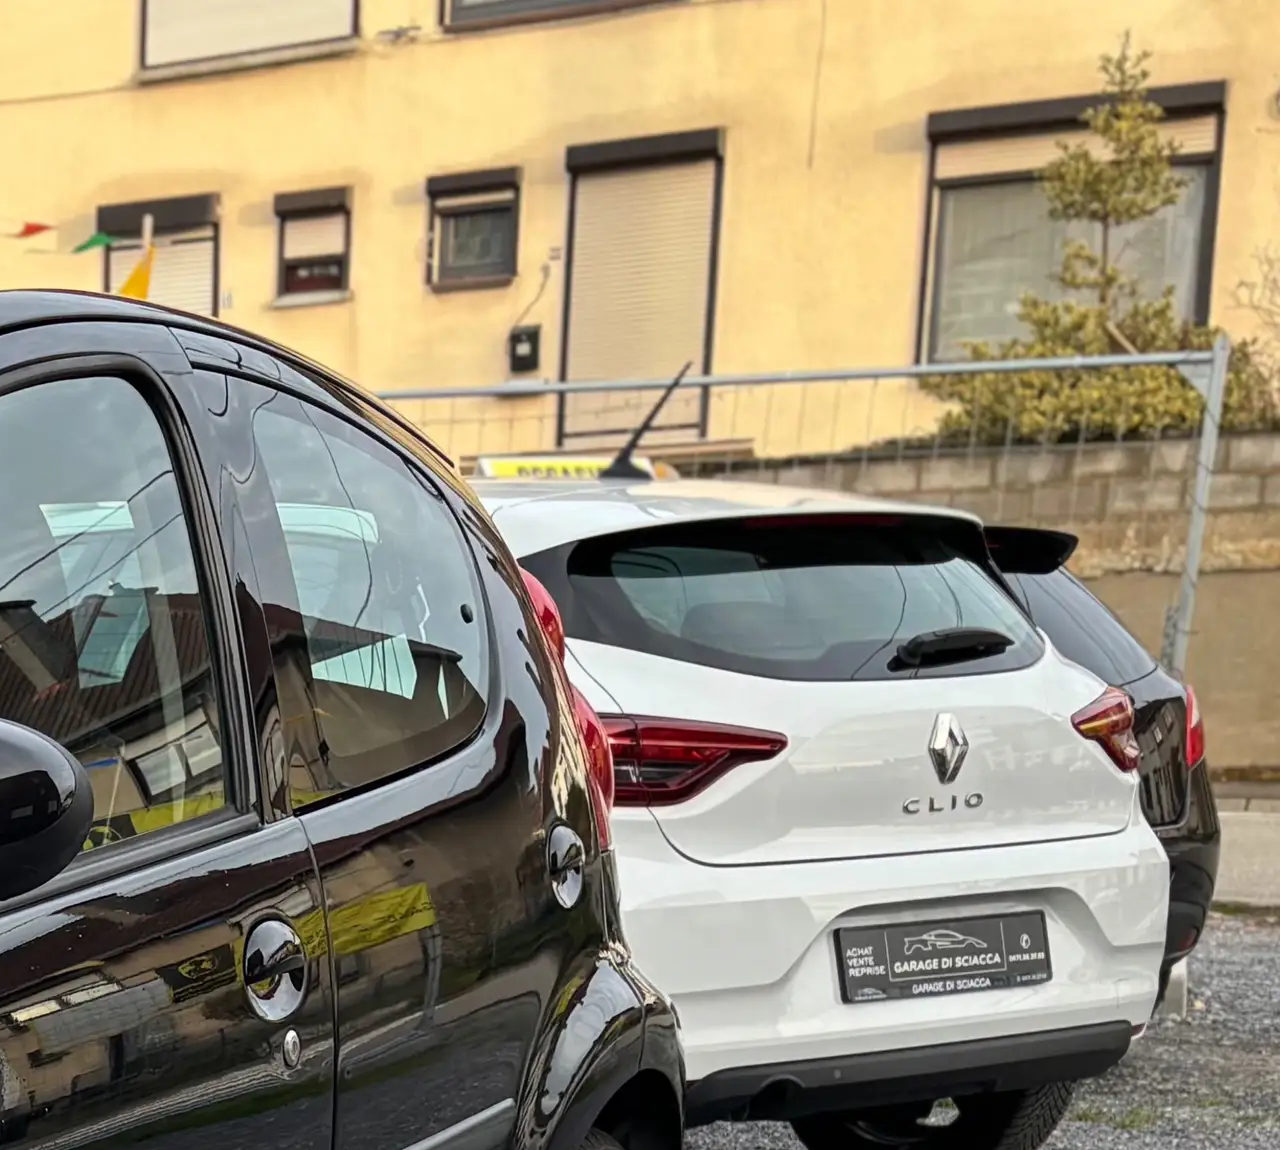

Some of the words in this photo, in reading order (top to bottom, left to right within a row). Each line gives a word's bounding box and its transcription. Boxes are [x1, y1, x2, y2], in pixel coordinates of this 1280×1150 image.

[902, 792, 984, 815] CLIO
[846, 946, 874, 958] ACHAT
[847, 956, 875, 967] VENTE
[894, 959, 939, 974] GARAGE
[941, 957, 953, 969] DI
[955, 953, 1002, 967] SCIACCA
[848, 965, 887, 977] REPRISE
[912, 981, 945, 995] GARAGE
[946, 980, 956, 991] DI
[956, 977, 992, 991] SCIACCA
